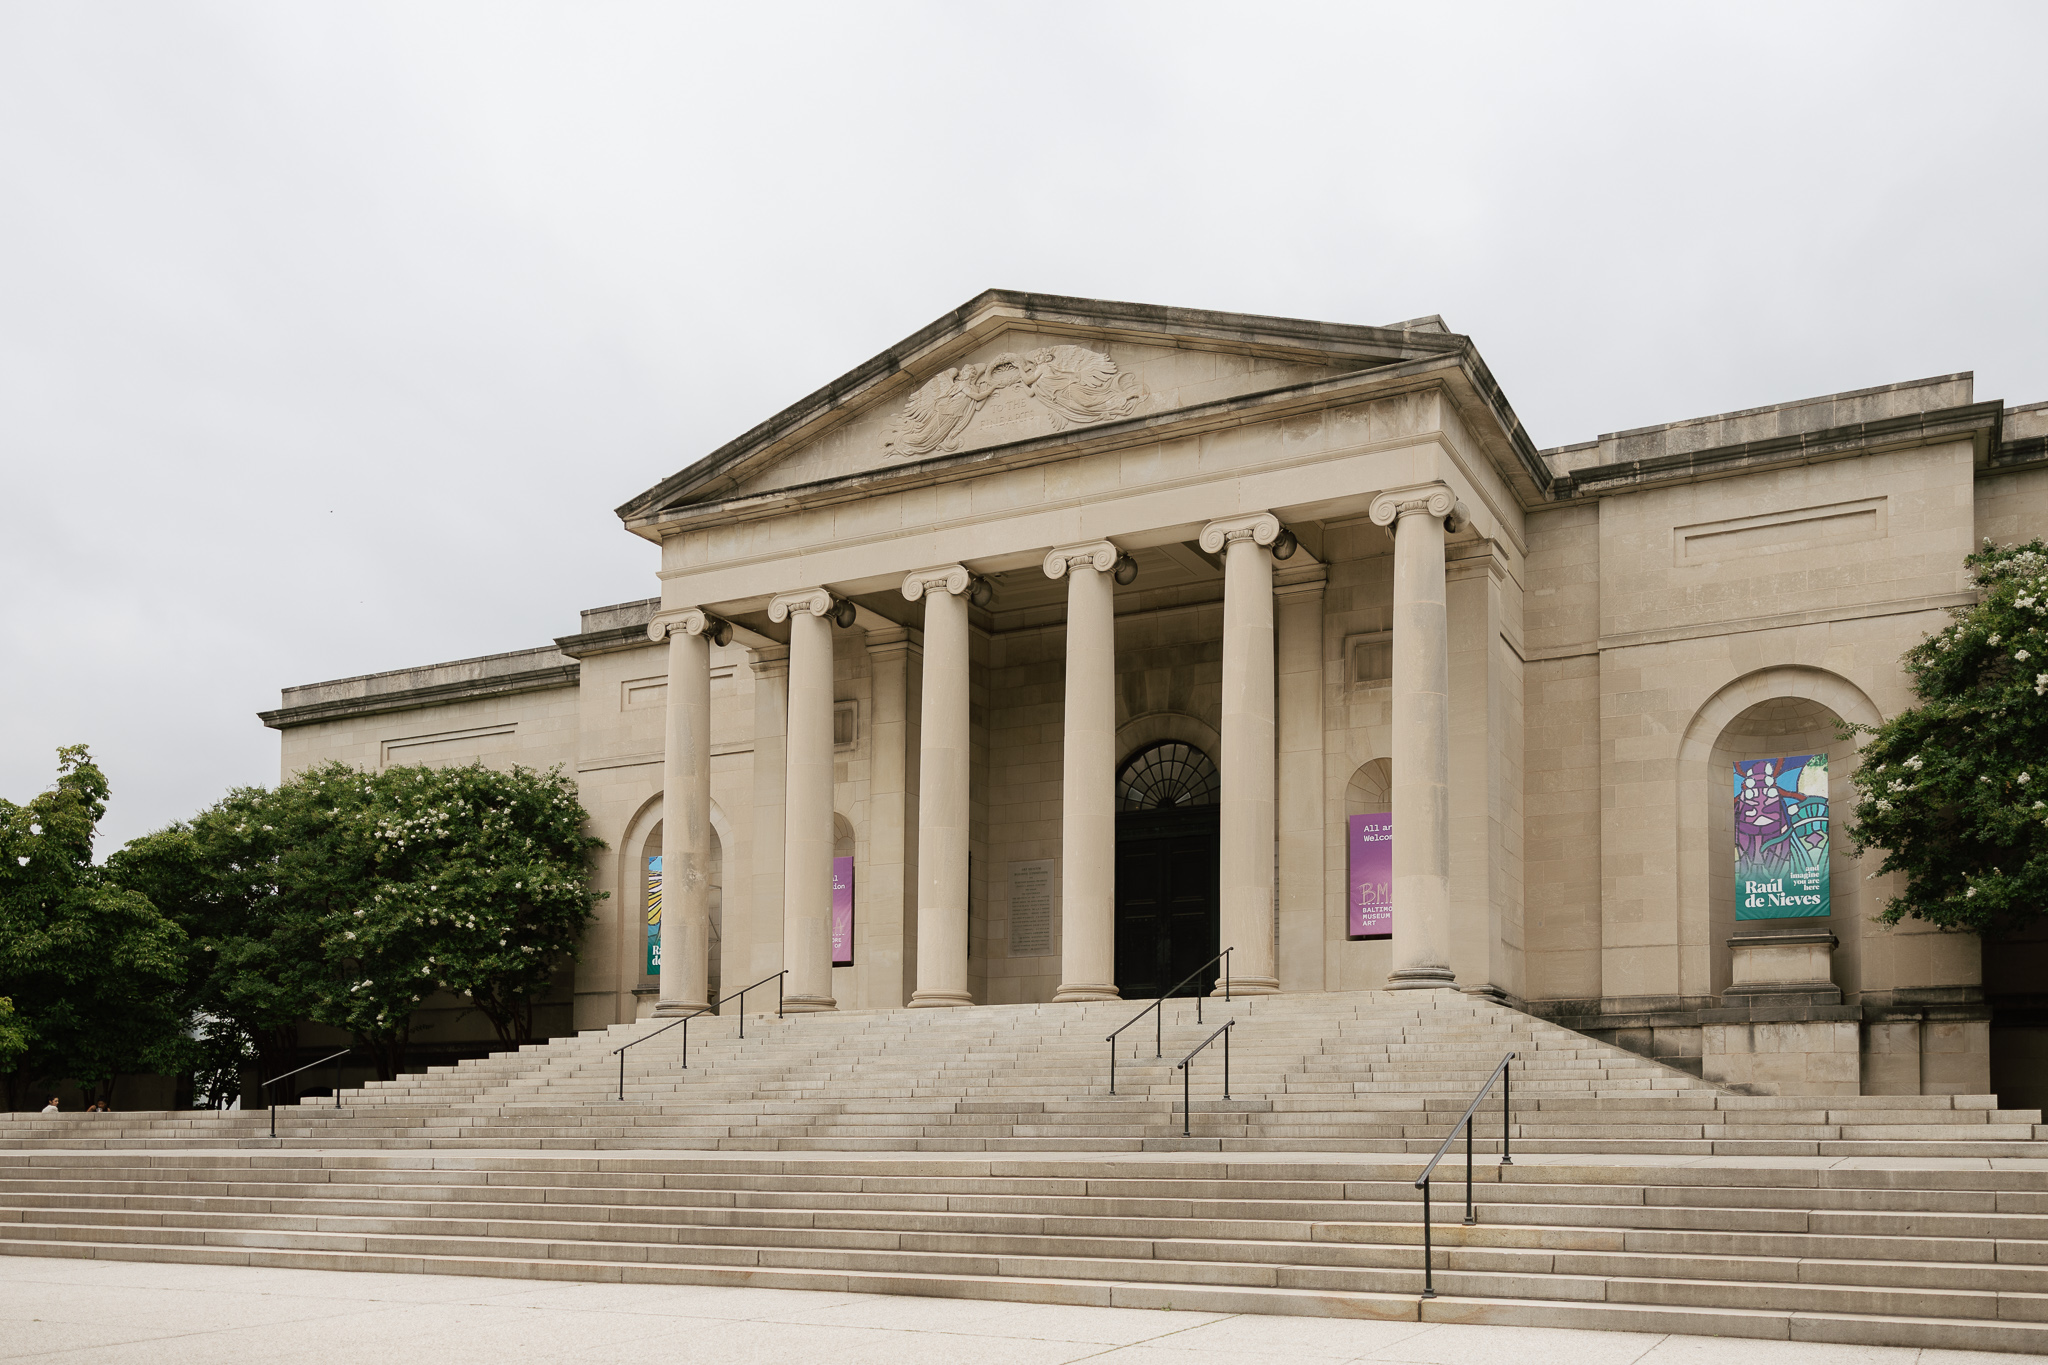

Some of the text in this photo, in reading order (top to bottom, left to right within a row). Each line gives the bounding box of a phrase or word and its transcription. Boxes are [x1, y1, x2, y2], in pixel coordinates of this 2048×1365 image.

[1363, 824, 1380, 832] All
[1790, 871, 1819, 879] imagine
[1744, 878, 1783, 894] Raúl
[1744, 892, 1821, 908] de Nieves
[1362, 912, 1391, 920] MUSEUM
